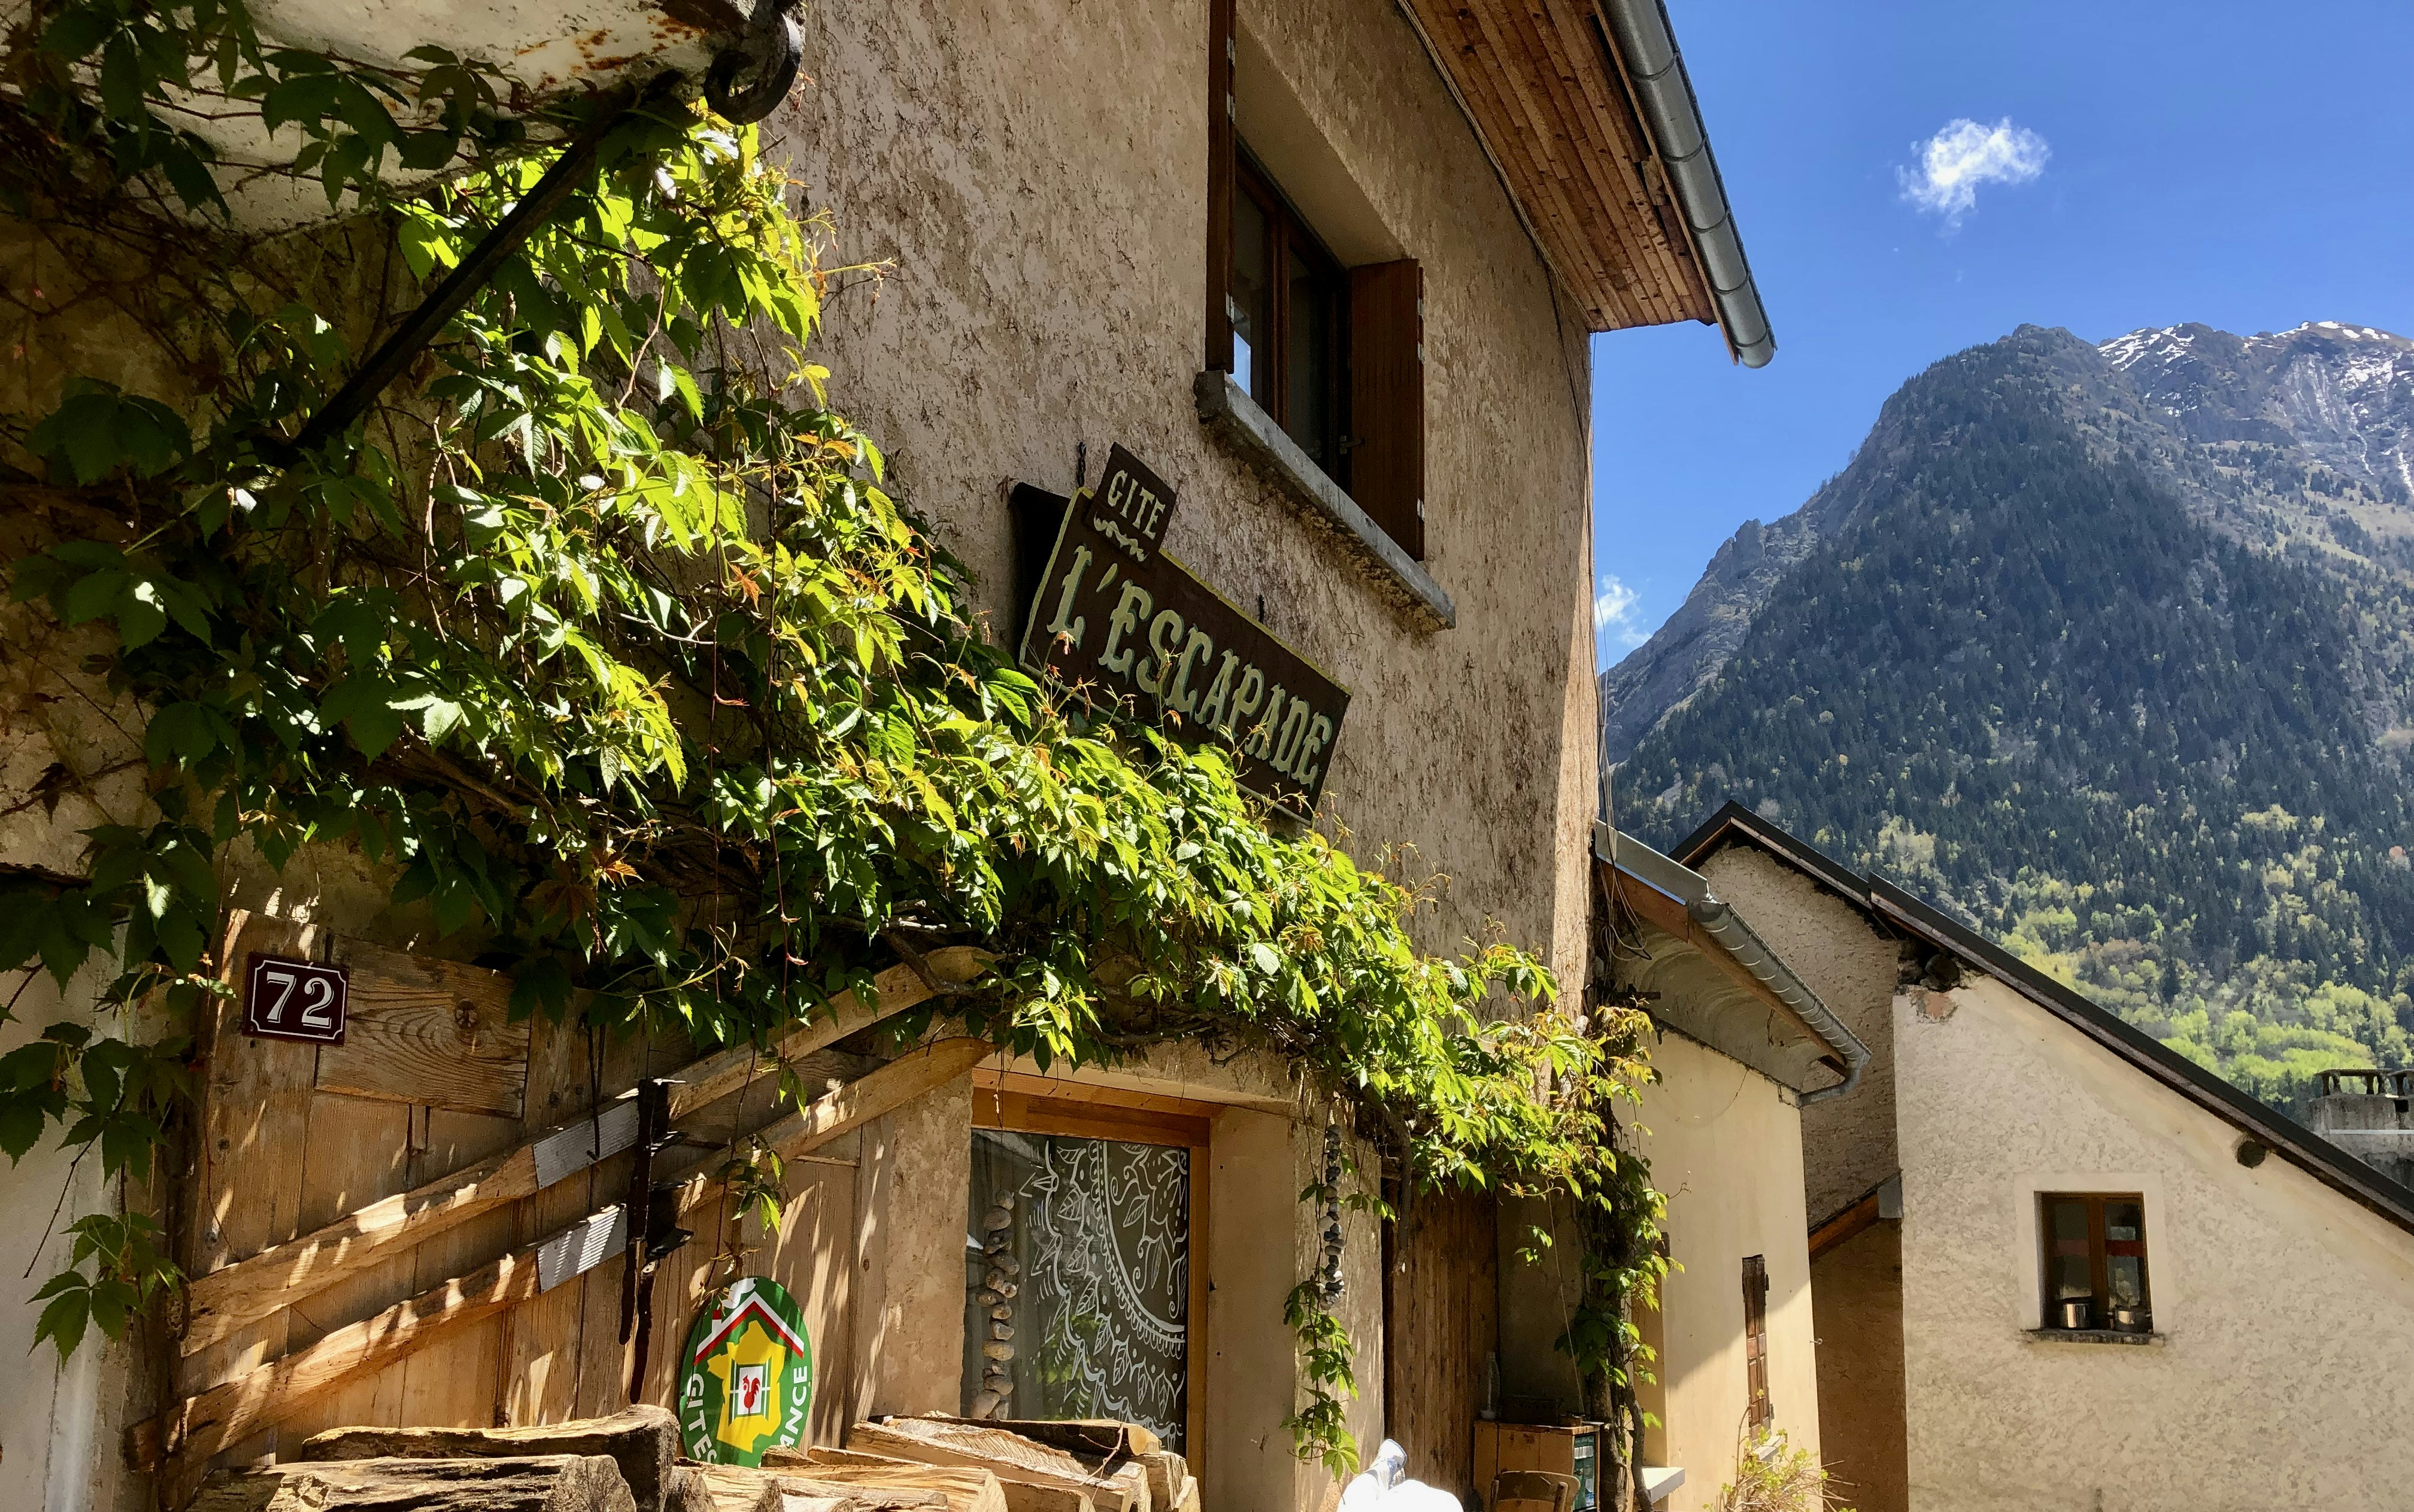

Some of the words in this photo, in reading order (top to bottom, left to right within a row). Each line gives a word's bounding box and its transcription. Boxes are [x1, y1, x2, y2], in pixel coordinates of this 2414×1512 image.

[1108, 470, 1166, 540] GITE
[1047, 545, 1333, 790] L'ESCAPADE
[266, 971, 334, 1029] 72
[780, 1365, 808, 1447] ANCE
